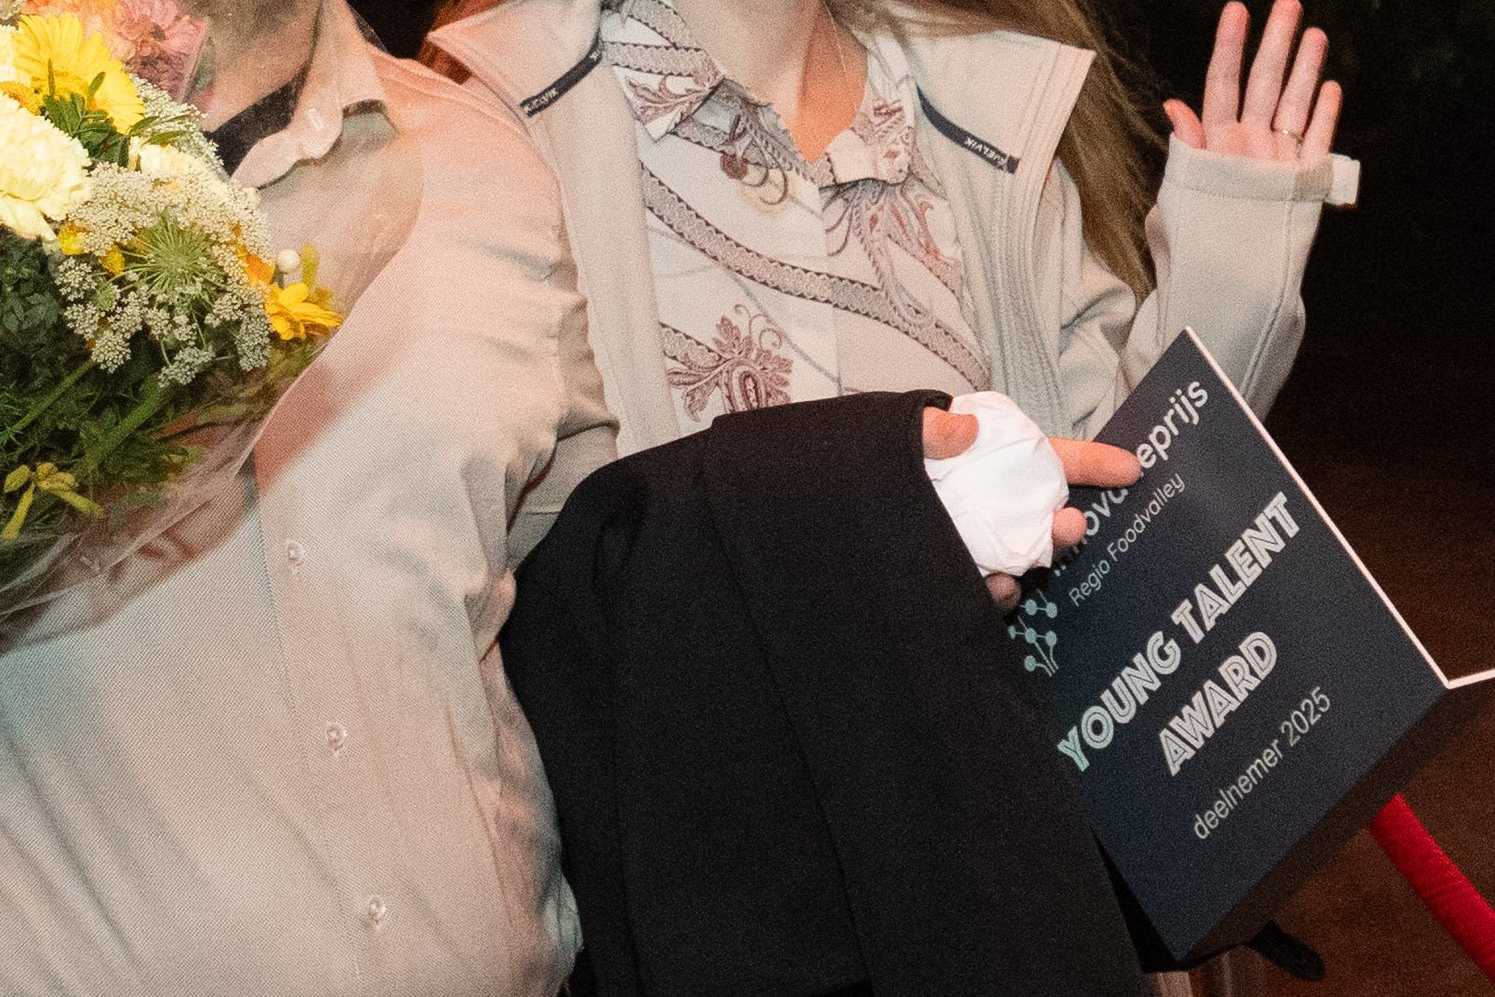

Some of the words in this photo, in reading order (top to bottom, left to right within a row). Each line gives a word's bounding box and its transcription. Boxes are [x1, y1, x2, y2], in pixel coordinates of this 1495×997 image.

[1068, 558, 1110, 607] Regio
[1107, 472, 1186, 563] Foodvalley
[1057, 630, 1181, 772] YOUNG
[1171, 491, 1300, 644] TALENT
[1159, 631, 1278, 777] AWARD
[1193, 738, 1283, 841] deelnemer
[1280, 686, 1332, 748] 2025
